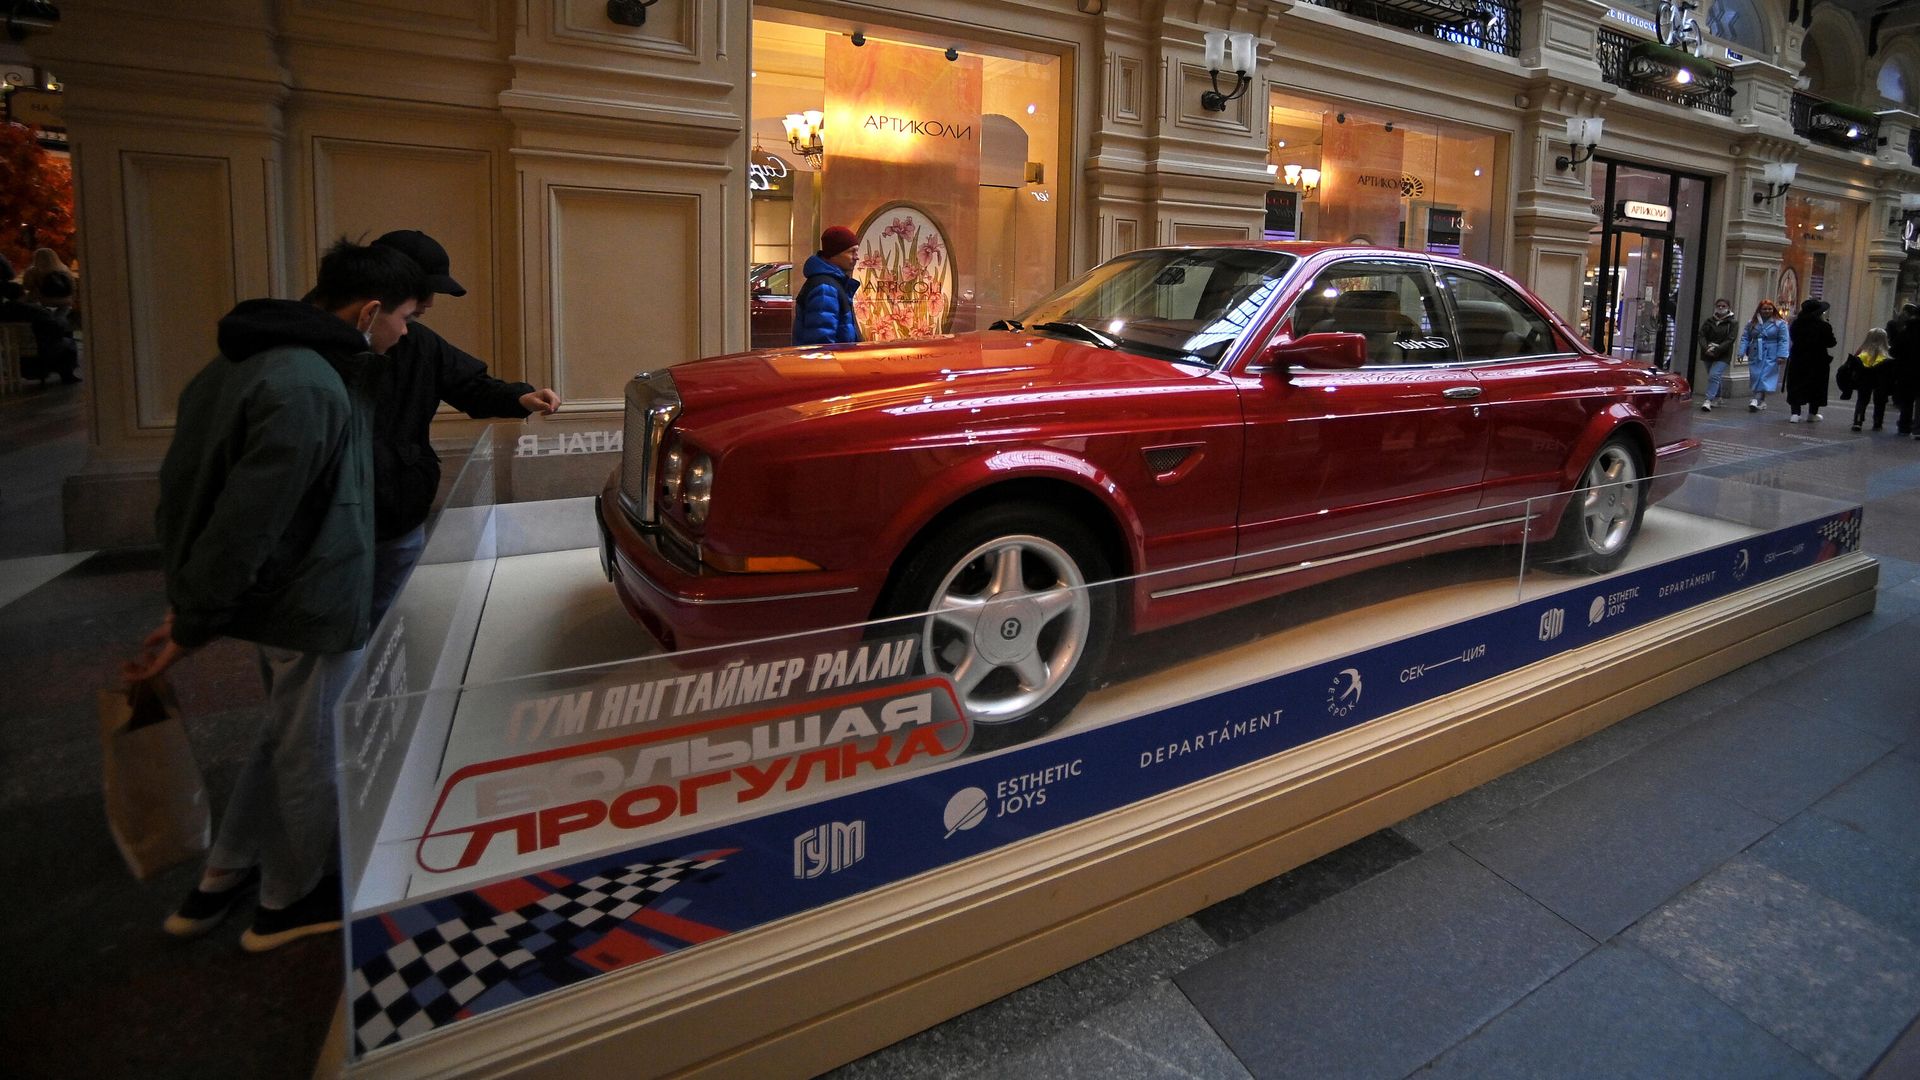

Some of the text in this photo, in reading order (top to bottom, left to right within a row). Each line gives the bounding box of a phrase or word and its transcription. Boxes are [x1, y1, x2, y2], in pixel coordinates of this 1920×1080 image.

[864, 115, 972, 141] АРТИКОЛИ
[1606, 603, 1626, 618] JOYS
[1608, 586, 1640, 606] ESTHETIC
[507, 638, 915, 744] ГУМ ЯНГТАЙМЕР РАЛЛИ
[1326, 676, 1356, 717] ВЕТЕРОК
[475, 693, 933, 818] БОЛЬШАЯ
[450, 728, 958, 869] ПРОГУЛКА
[996, 758, 1083, 800] ESTHETIC
[995, 787, 1048, 819] JOYS
[793, 819, 867, 881] ГУМ
